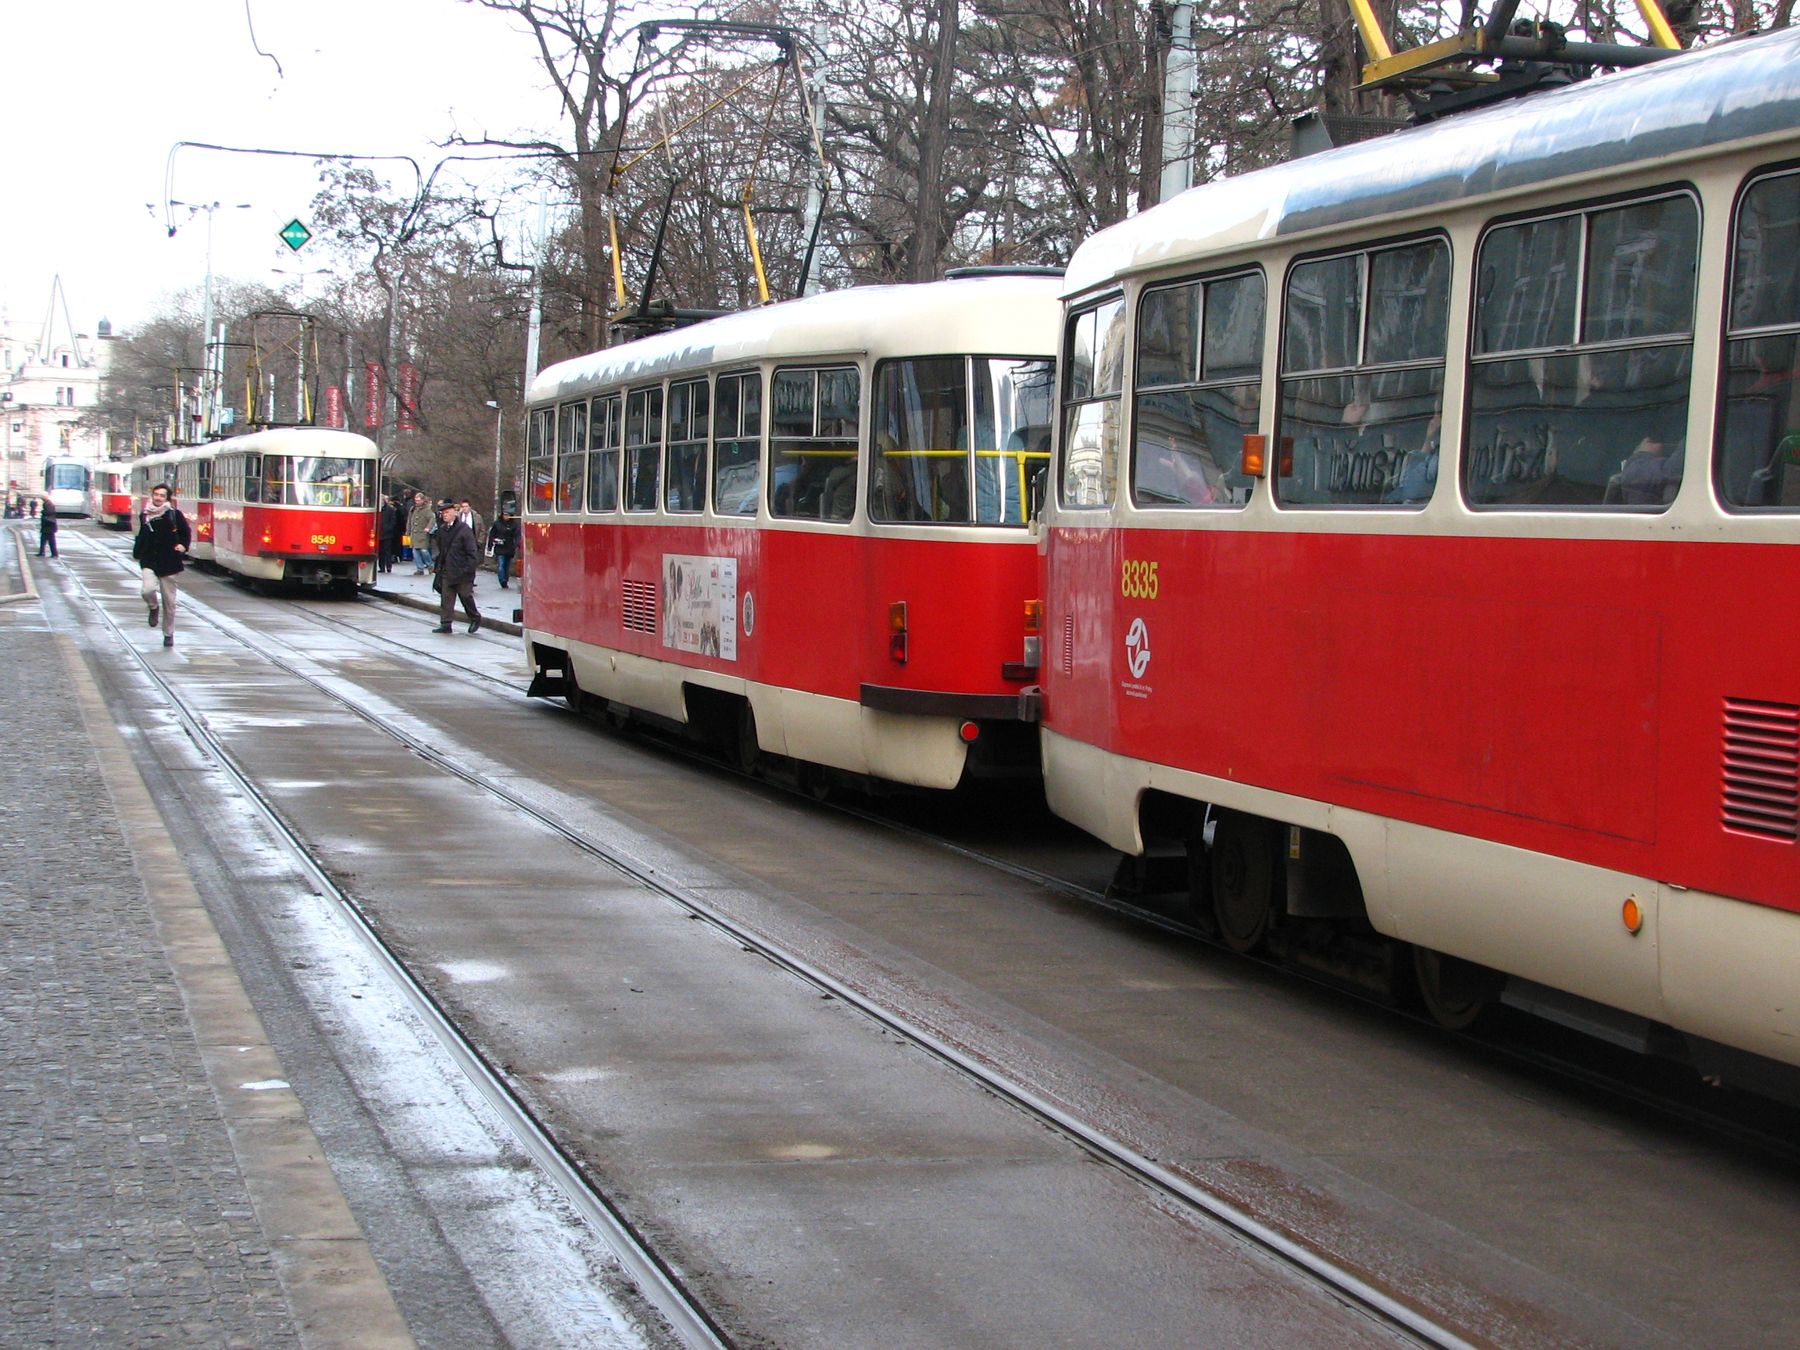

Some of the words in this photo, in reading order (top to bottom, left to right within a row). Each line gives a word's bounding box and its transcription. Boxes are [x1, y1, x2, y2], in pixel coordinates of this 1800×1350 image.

[316, 490, 332, 505] 10
[311, 534, 336, 545] 8549
[1121, 559, 1159, 600] 8335
